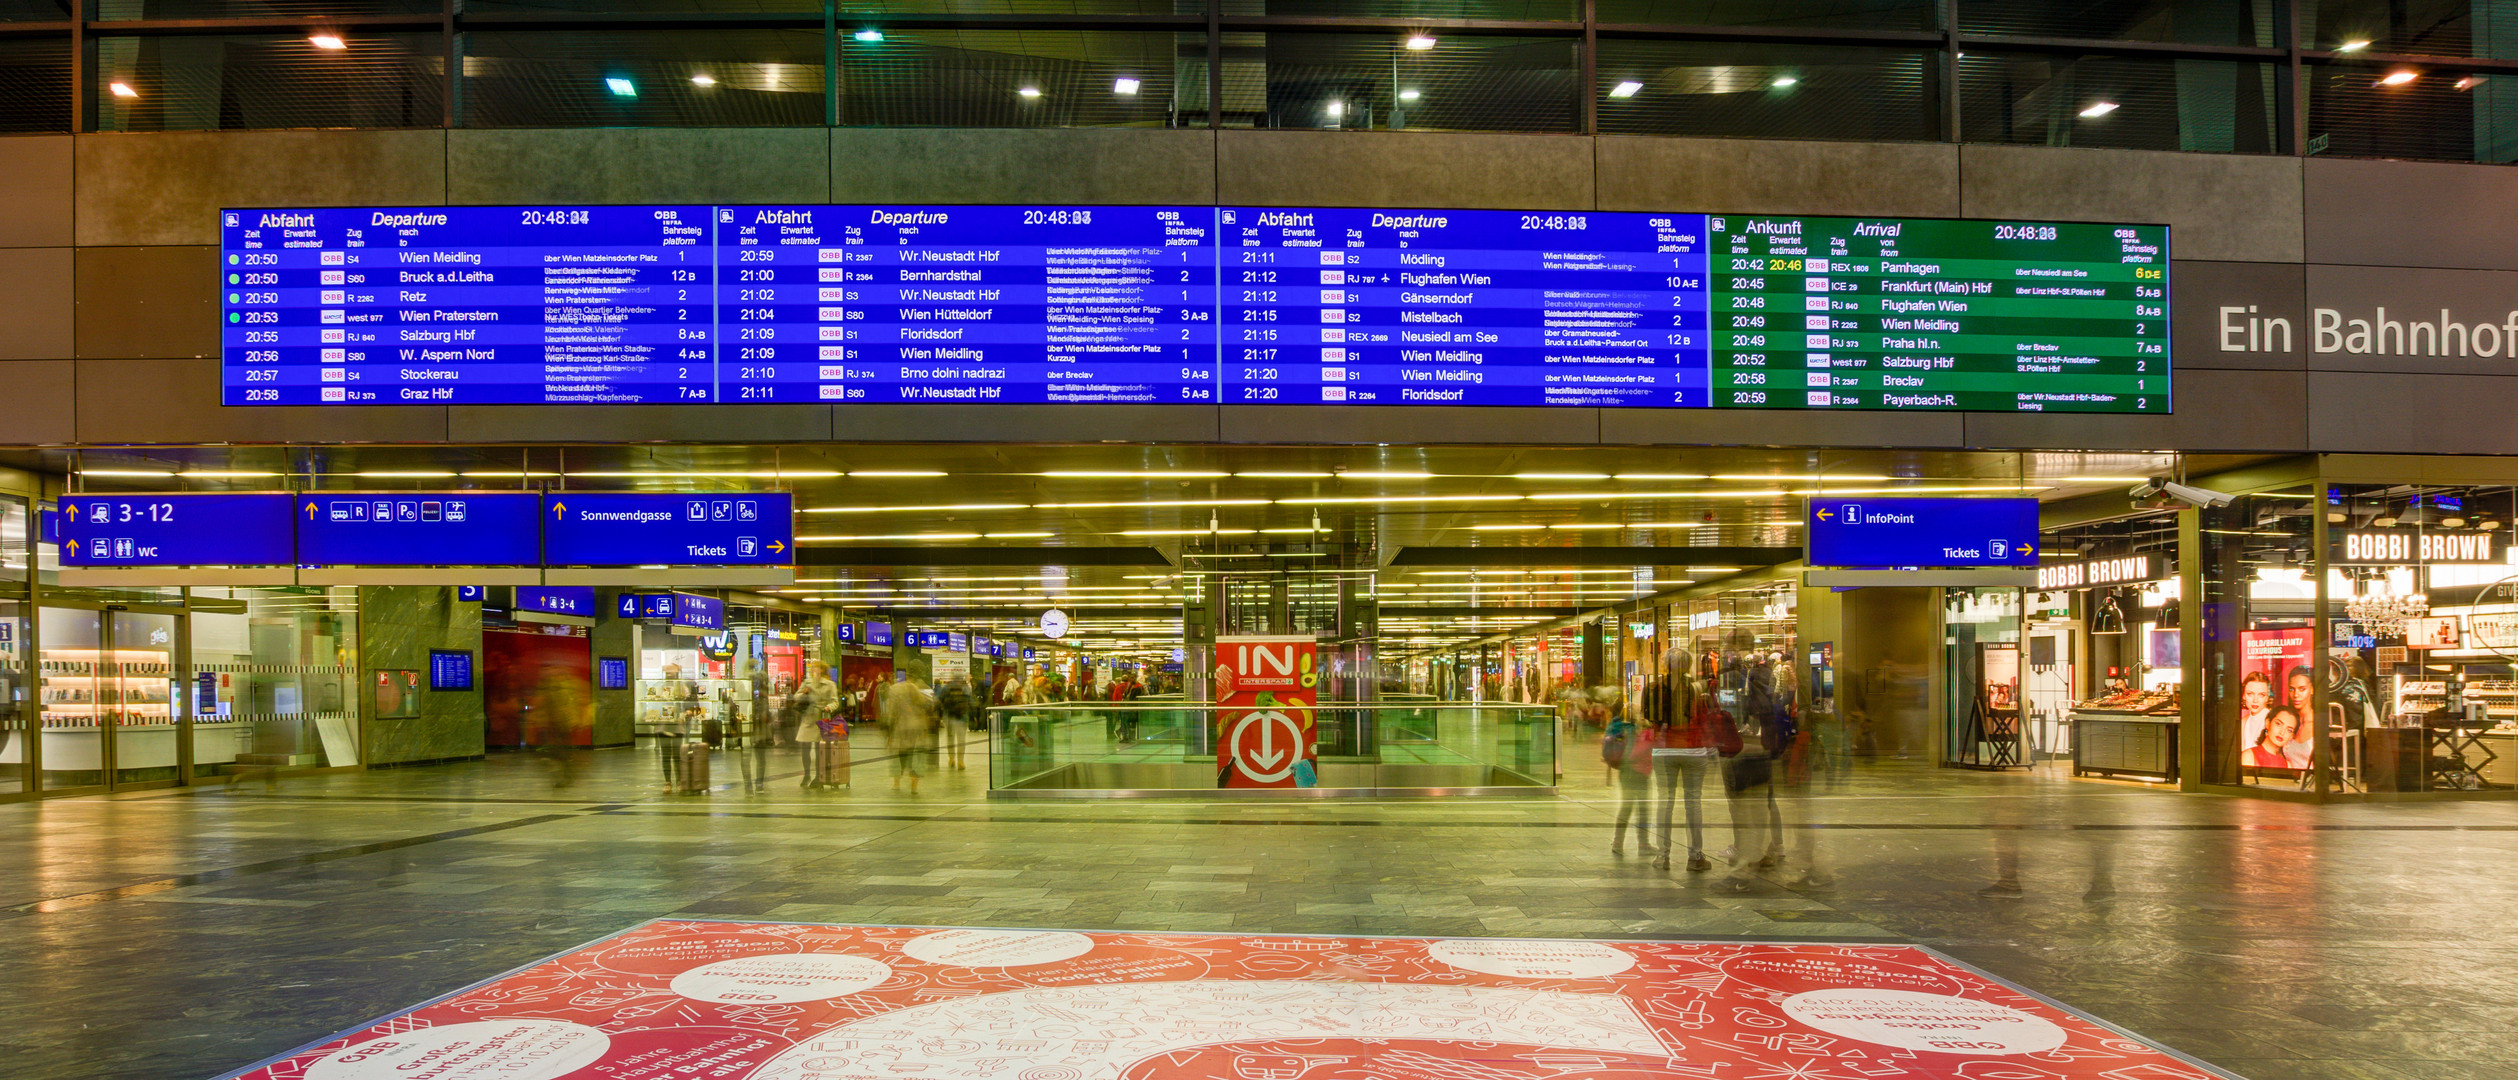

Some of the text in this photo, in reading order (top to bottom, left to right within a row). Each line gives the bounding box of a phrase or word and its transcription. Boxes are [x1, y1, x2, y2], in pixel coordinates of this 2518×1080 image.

[259, 213, 315, 228] Abfahrt
[371, 212, 447, 228] Departure
[755, 209, 812, 224] Abfahrt
[870, 210, 948, 226] Departure
[1257, 212, 1314, 227] Abfahrt
[1371, 213, 1448, 229] Departure
[1745, 220, 1802, 235] Ankunft
[1853, 222, 1900, 237] Arrival
[245, 251, 481, 266] 20:50 Wien Meidling
[898, 249, 1001, 262] Wr.Neustadt Hbf
[1400, 253, 1445, 268] Mödling
[1731, 258, 1764, 271] 20:42
[1769, 258, 1802, 271] 20:46
[244, 270, 494, 285] 20:50 Bruck a.d.Leitha
[900, 269, 982, 281] Bernhardsthal
[1400, 272, 1491, 287] Flughafen Wien
[1731, 277, 1993, 296] 20:45 Frankfurt (Main) Hbf
[245, 290, 427, 304] 20:50 Retz
[899, 288, 1001, 301] Wr.Neustadt Hbf
[1400, 291, 1474, 304] Gänserndorf
[1732, 296, 1968, 314] 20:48 Flughafen Wien
[245, 309, 499, 324] 20:53 Wien Praterstern
[899, 308, 993, 320] Wien Hütteldorf
[1401, 311, 1463, 324] Mistelbach
[1732, 315, 1960, 334] 20:49 Wien Meidling
[2219, 305, 2518, 359] Ein Bahnhof
[245, 328, 476, 344] 20:55 Salzburg Hbf
[900, 327, 964, 340] Floridsdorf
[1401, 330, 1499, 343] Neusiedl am See
[1732, 334, 1766, 347] 20:49
[1882, 336, 1916, 349] Praha
[245, 350, 279, 362] 20:56
[420, 348, 463, 363] Aspern
[465, 348, 495, 360] Nord
[899, 347, 984, 362] Wien Meidling
[1400, 349, 1483, 365] Wien Meidling
[1732, 353, 1955, 371] 20:52 Salzburg Hbf
[245, 368, 459, 382] 20:57 Stockerau
[900, 366, 1006, 379] Brno dolni nadrazi
[1401, 369, 1483, 384] Wien Meidling
[1733, 372, 1925, 387] 20:58 Breclav
[245, 387, 454, 401] 20:58 Graz Hbf
[900, 386, 1002, 398] Wr.Neustadt Hbf
[1402, 388, 1464, 401] Floridsdorf
[1733, 391, 1958, 408] 20:59 Payerbach-R.
[118, 503, 133, 522] 3
[355, 506, 364, 517] R
[399, 505, 408, 516] P
[581, 509, 672, 522] Sonnwendgasse
[723, 504, 730, 513] P
[739, 504, 746, 513] P
[1865, 512, 1914, 525] InfoPoint
[138, 546, 158, 557] WC
[687, 544, 727, 557] Tickets
[1943, 547, 1980, 559] Tickets
[2347, 534, 2491, 560] BOBBI BROWN
[2038, 556, 2148, 589] BOBBI BROWN
[560, 598, 575, 610] 3-4
[622, 599, 636, 614] 4
[841, 626, 850, 638] 5
[907, 635, 915, 644] 6
[993, 646, 999, 654] 7
[1024, 650, 1031, 658] 8
[2247, 647, 2283, 655] LUXURIOUS
[1238, 645, 1294, 676] IN
[1113, 960, 1194, 976] Bahnhof
[1741, 960, 1843, 973] Bahnhof
[1800, 976, 1858, 986] Jahre
[1812, 1012, 2025, 1024] Geburtstagsfest
[1884, 1022, 1982, 1032] Großes
[395, 1039, 471, 1072] Großes
[595, 1046, 674, 1074] 5 Jahre
[616, 1031, 755, 1080] Hauptbahnhof
[679, 1038, 774, 1077] Bahnhof
[708, 1058, 755, 1078] alle
